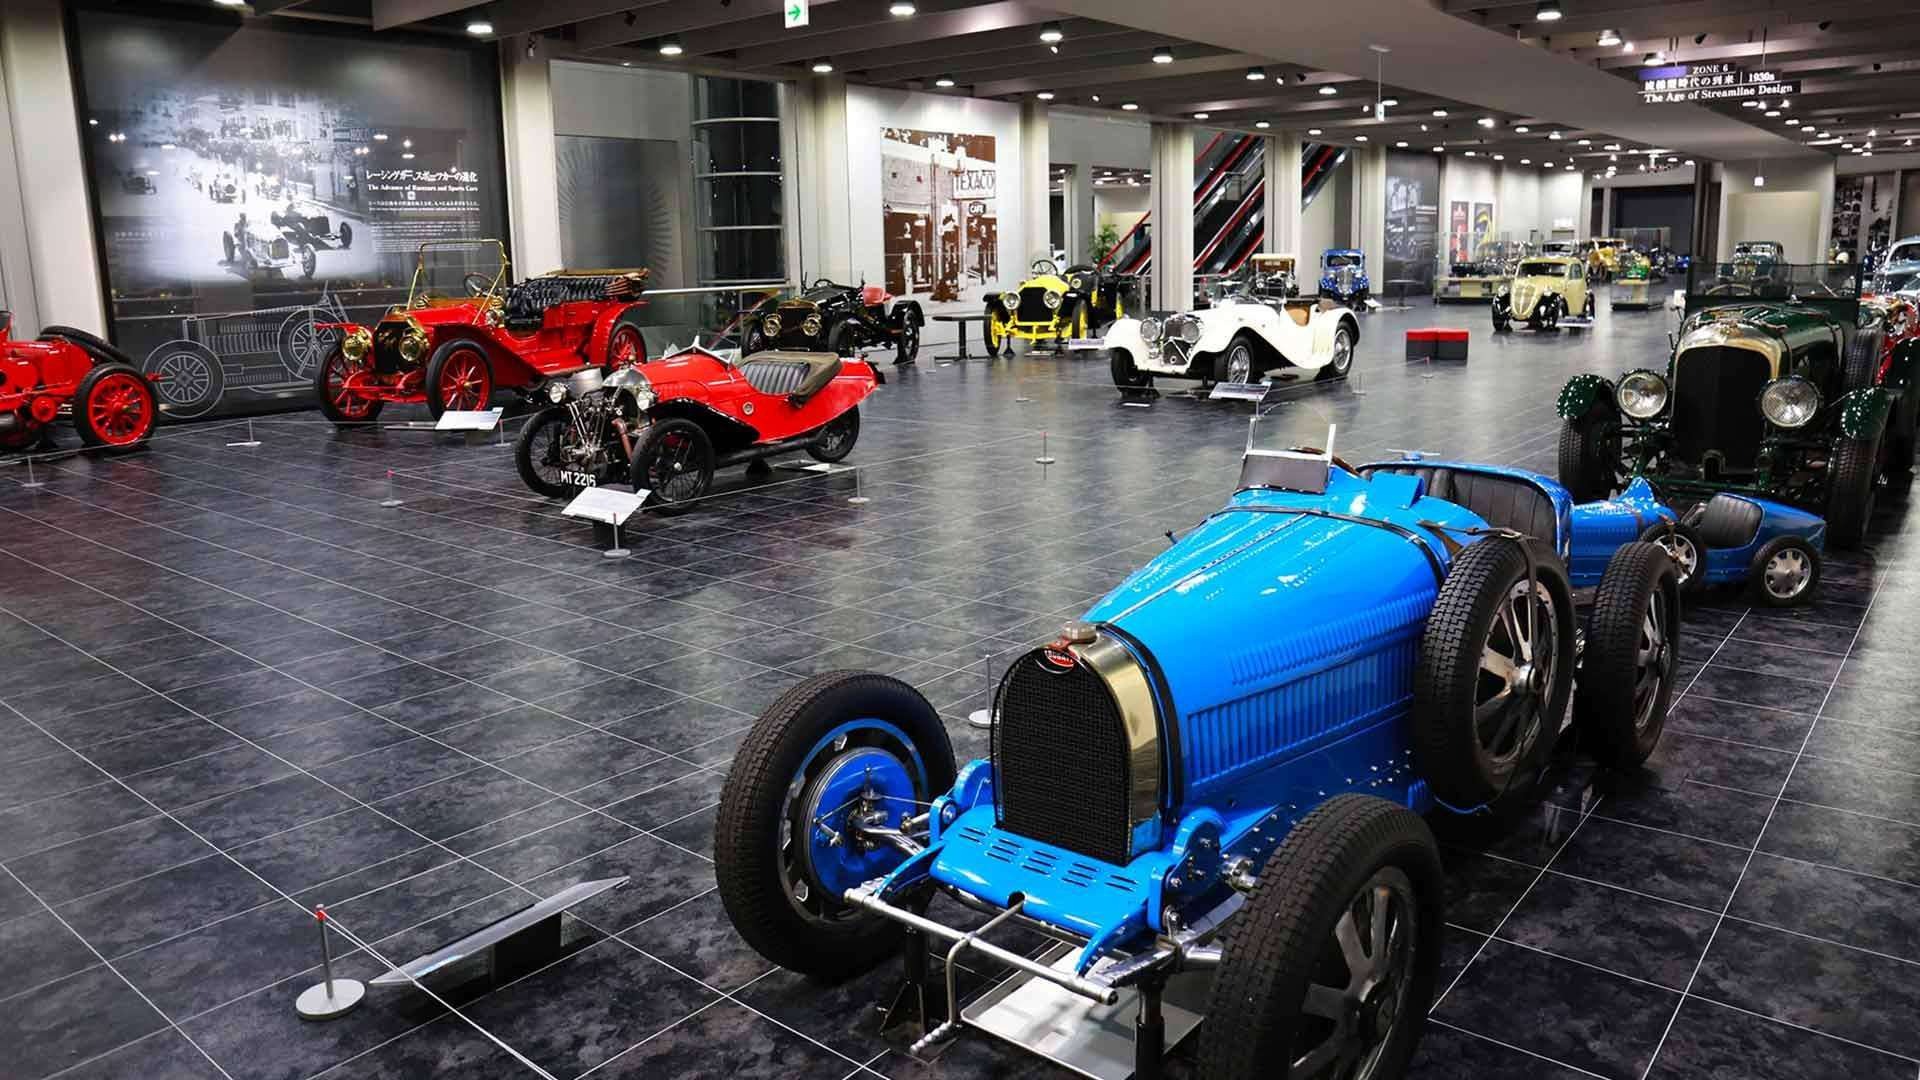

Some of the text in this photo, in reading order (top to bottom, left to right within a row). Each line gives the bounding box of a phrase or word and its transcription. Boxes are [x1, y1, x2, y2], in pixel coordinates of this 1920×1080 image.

[1692, 63, 1729, 75] ZONE 6
[1748, 72, 1776, 83] 1930s
[1644, 84, 1793, 104] The Age of Streamline Design
[954, 174, 994, 191] TEXACO
[560, 470, 572, 484] MT
